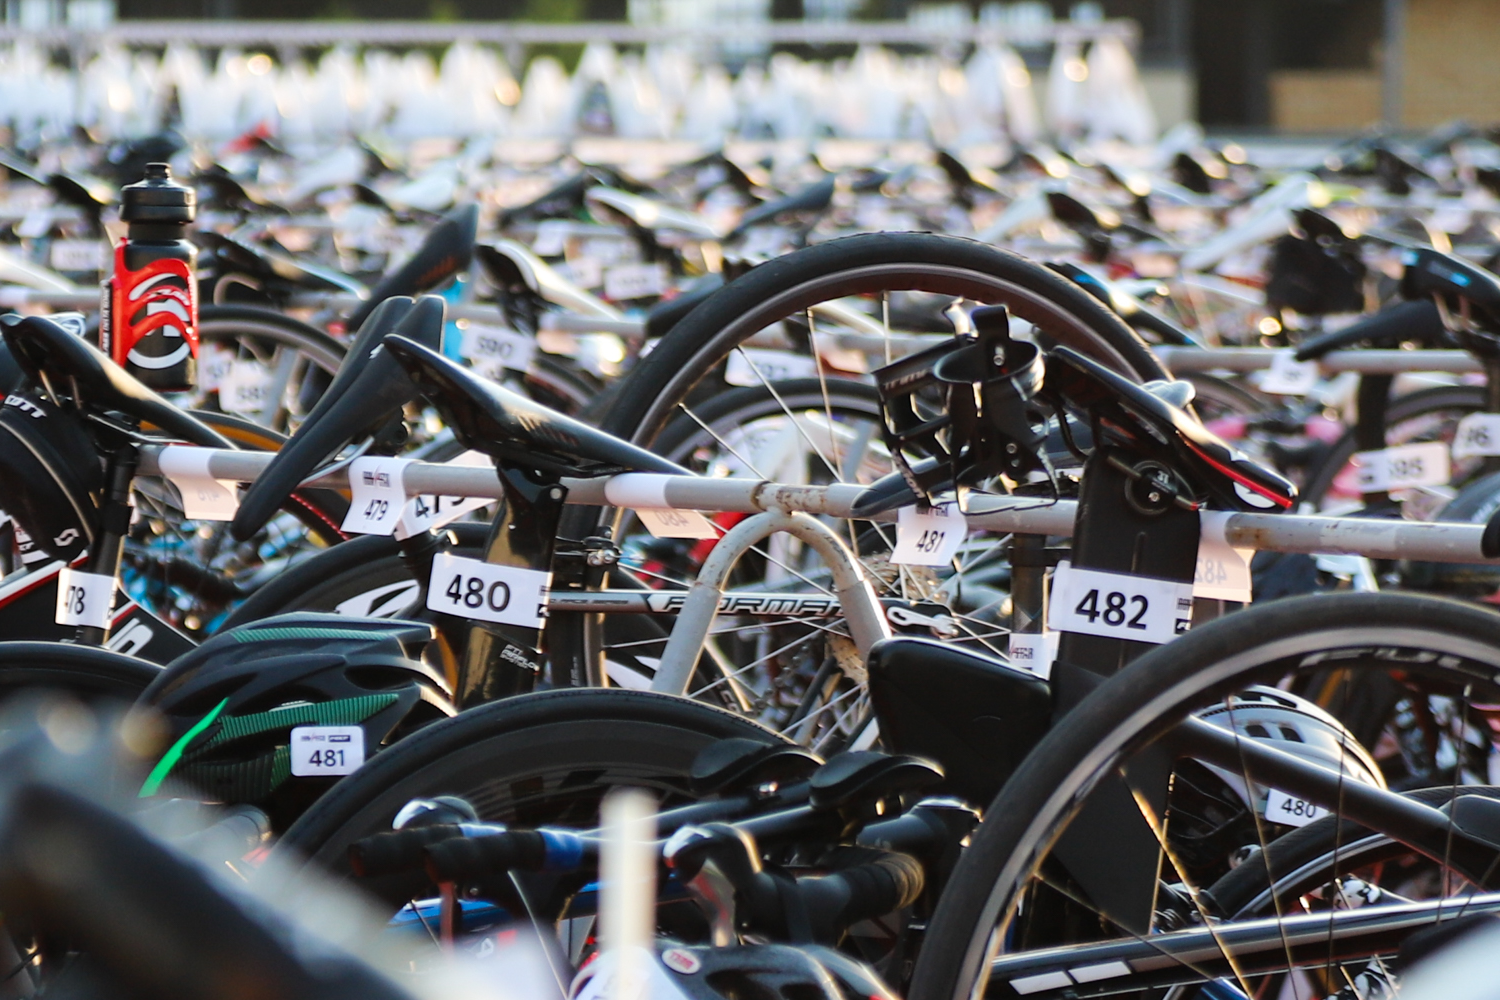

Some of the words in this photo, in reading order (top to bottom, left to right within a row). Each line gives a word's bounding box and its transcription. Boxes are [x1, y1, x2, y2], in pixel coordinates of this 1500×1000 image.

[363, 499, 389, 521] 479
[915, 530, 946, 553] 481
[64, 585, 86, 615] 78
[445, 573, 511, 613] 480
[1074, 588, 1149, 631] 482
[308, 749, 345, 767] 481
[1280, 798, 1316, 818] 480
